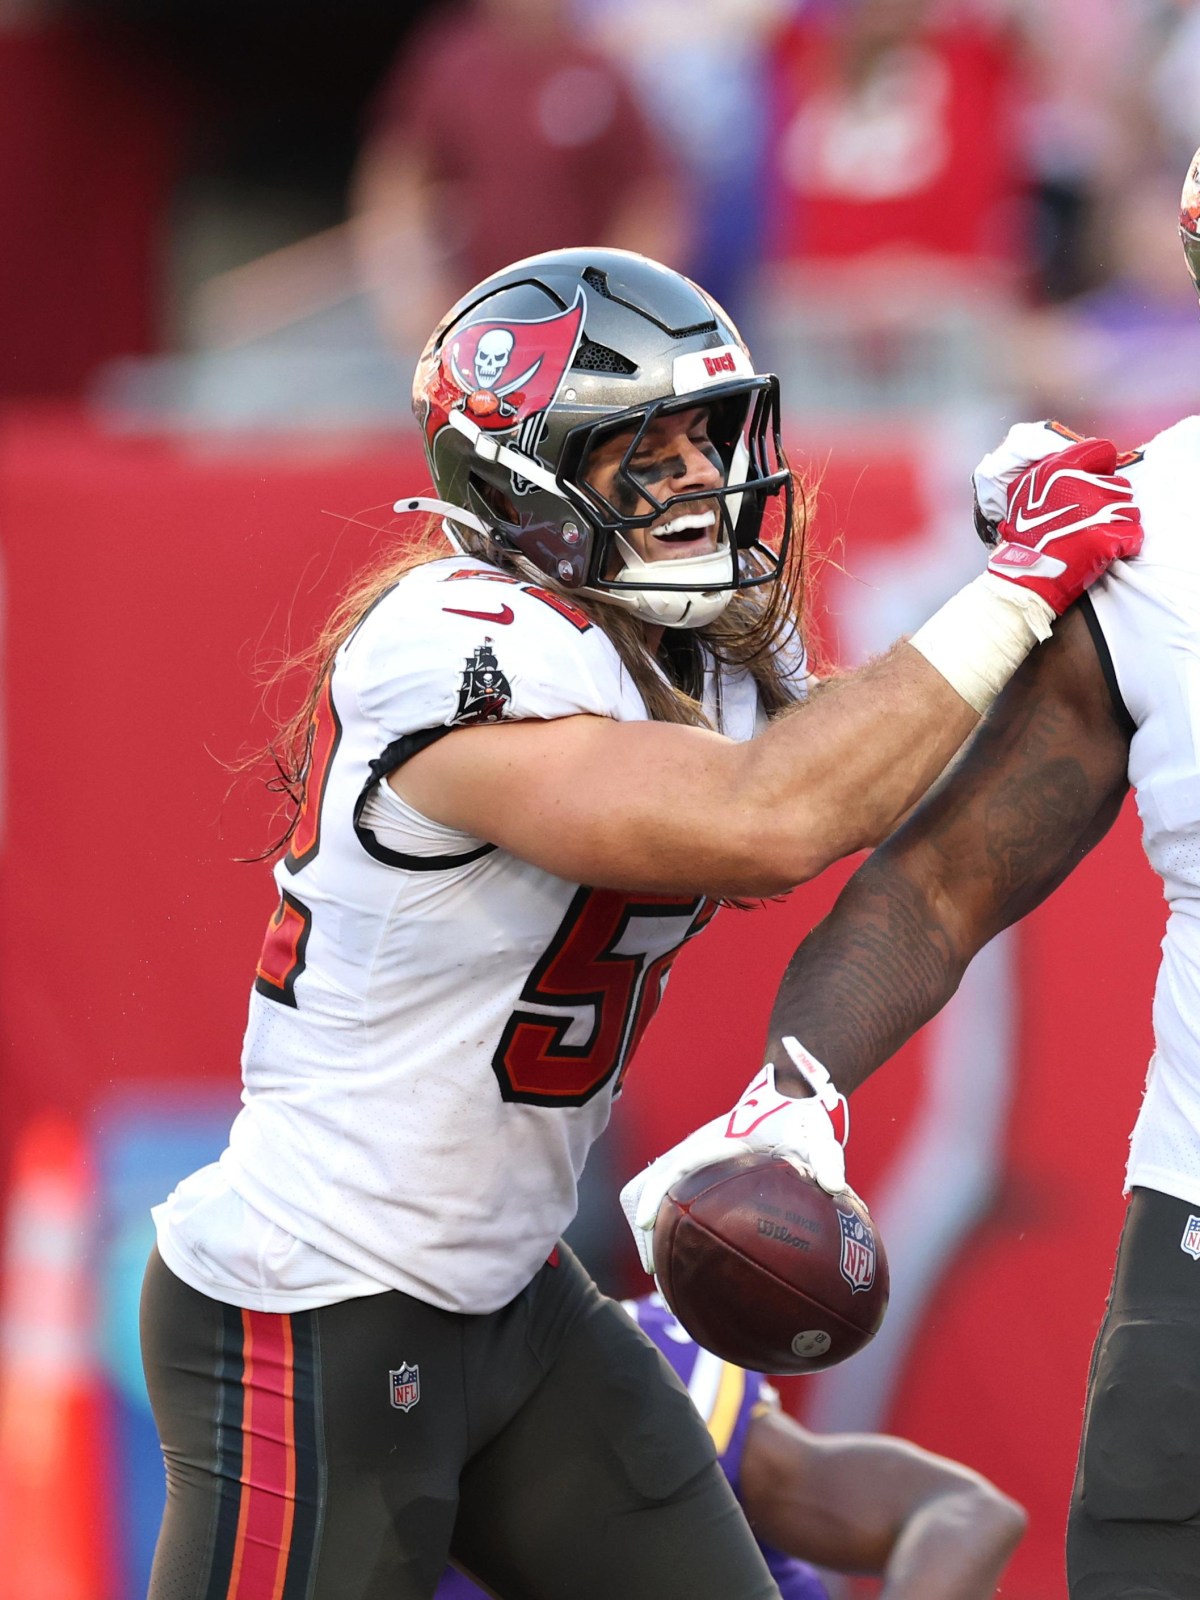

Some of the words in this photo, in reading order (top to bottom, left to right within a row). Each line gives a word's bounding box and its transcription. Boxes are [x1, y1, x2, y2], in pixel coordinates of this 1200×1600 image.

[703, 352, 736, 376] BUCS
[491, 884, 722, 1108] 5
[757, 1218, 811, 1252] Wilson
[844, 1240, 872, 1283] NFL
[395, 1384, 417, 1404] NFL
